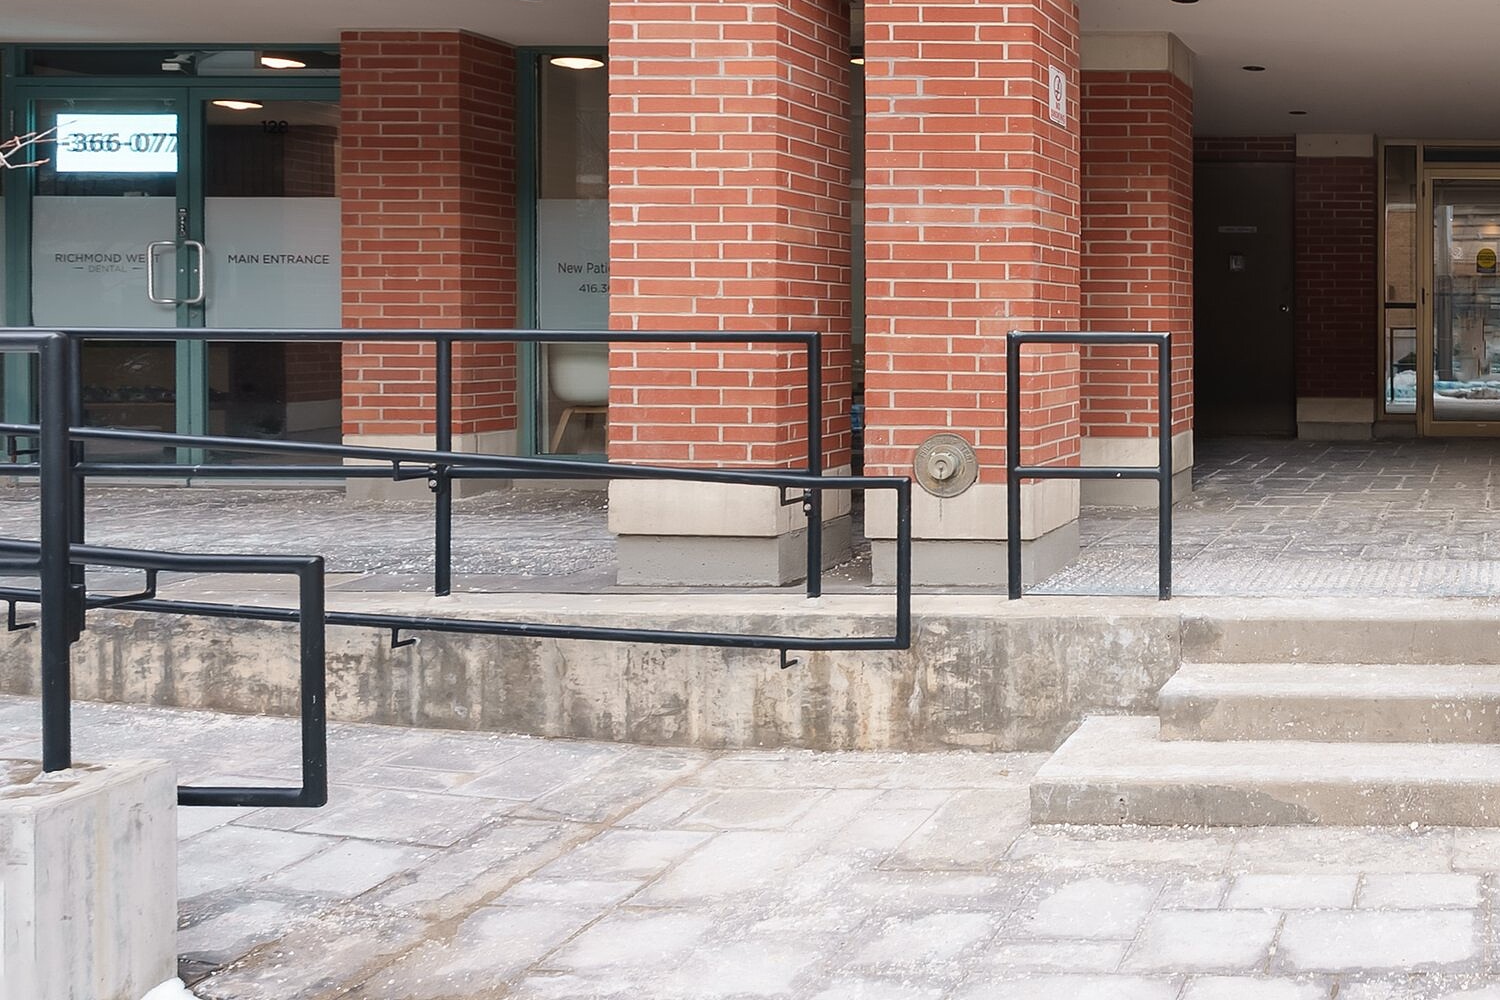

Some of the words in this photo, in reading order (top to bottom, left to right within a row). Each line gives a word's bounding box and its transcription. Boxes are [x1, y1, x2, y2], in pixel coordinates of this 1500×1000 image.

[261, 120, 289, 134] 128
[55, 253, 122, 263] RICHMOND
[126, 253, 160, 263] WET
[228, 254, 259, 264] MAIN
[263, 254, 330, 265] ENTRANCE
[88, 264, 127, 273] DENTAL
[558, 262, 583, 273] New
[587, 262, 609, 274] Pati
[579, 283, 609, 293] 416.3
